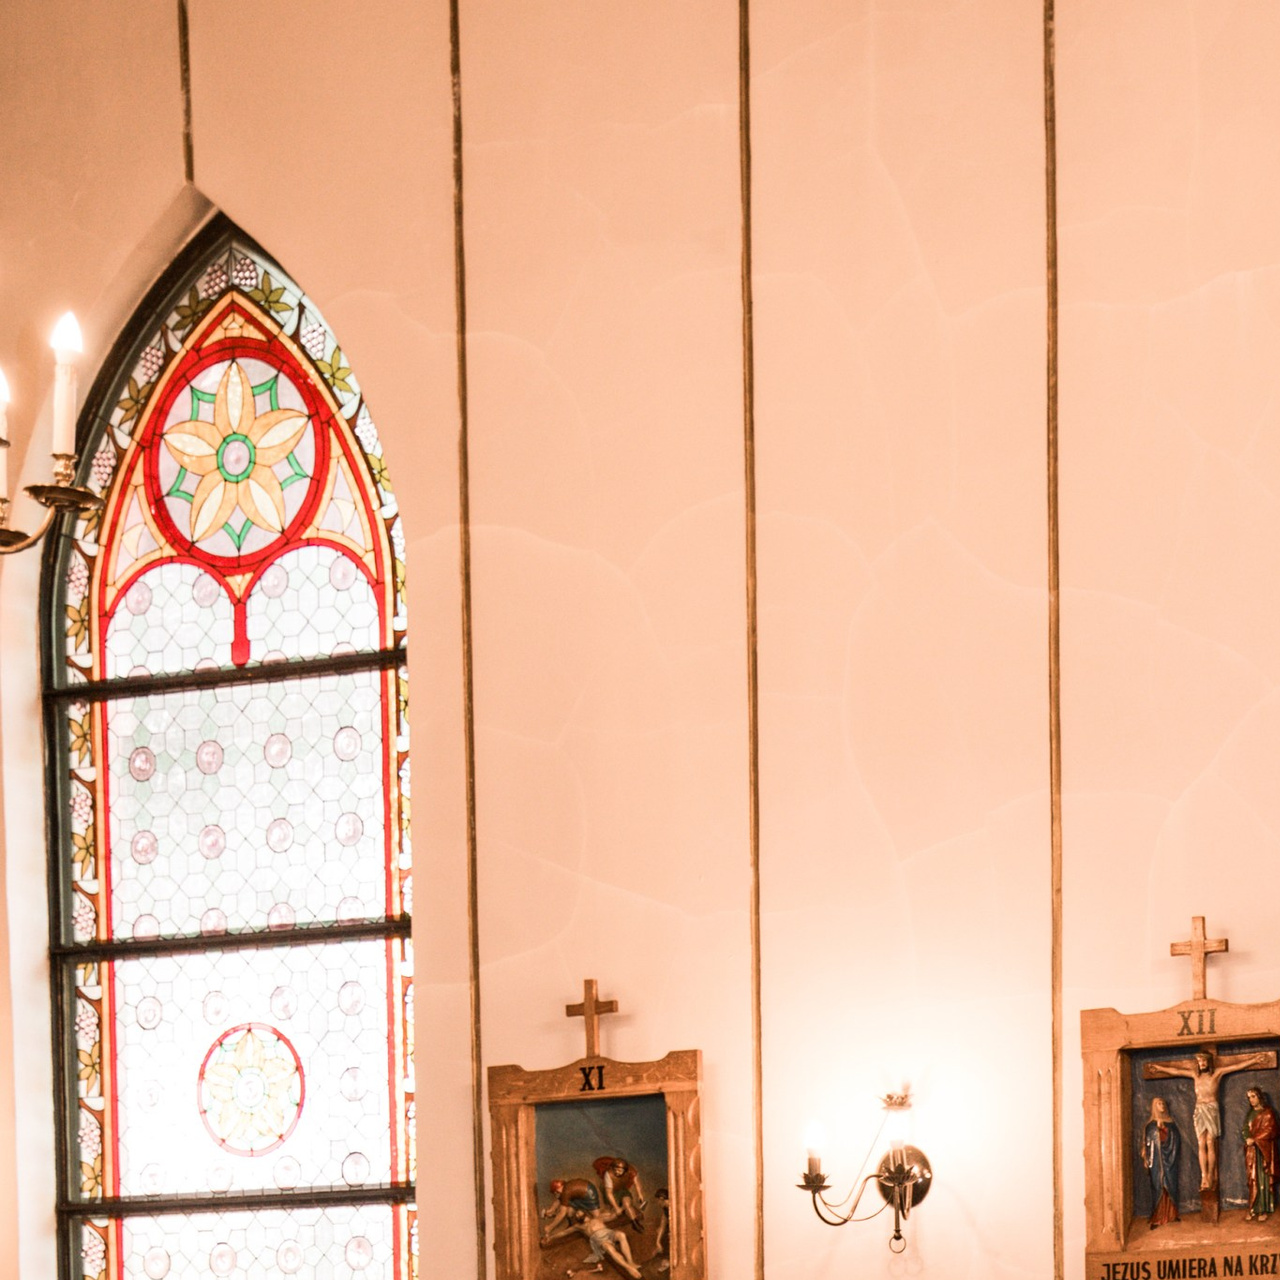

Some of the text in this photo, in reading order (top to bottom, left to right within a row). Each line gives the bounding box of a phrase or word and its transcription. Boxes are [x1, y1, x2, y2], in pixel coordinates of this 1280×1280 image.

[1177, 1009, 1217, 1036] XII
[579, 1066, 605, 1091] XI
[1157, 1257, 1217, 1280] UMIERA
[1223, 1255, 1244, 1277] NA
